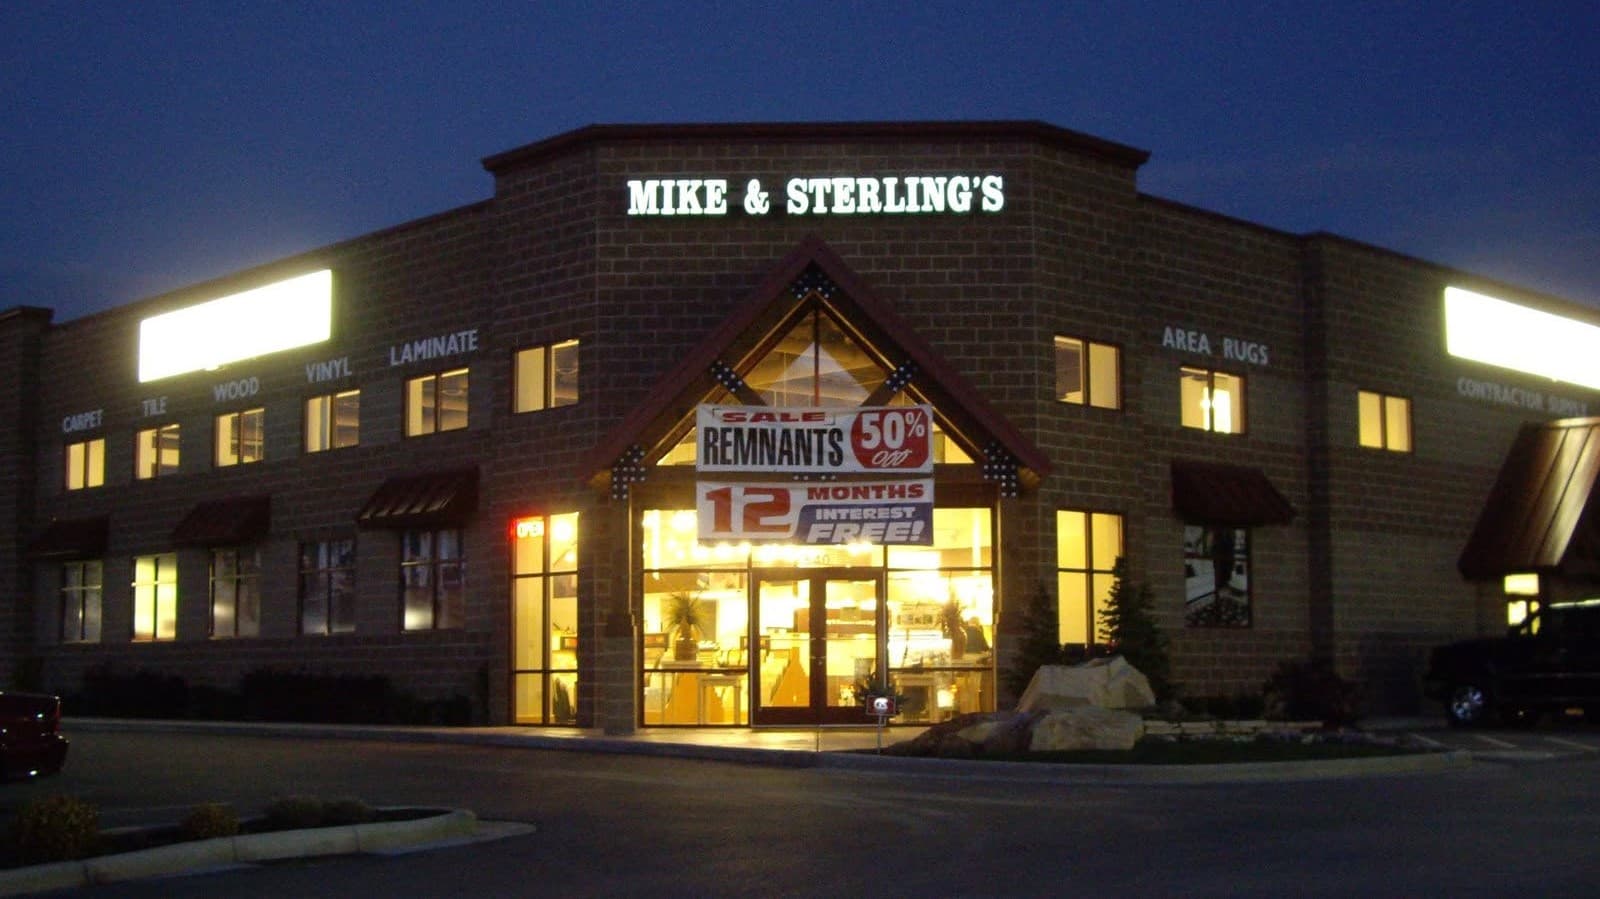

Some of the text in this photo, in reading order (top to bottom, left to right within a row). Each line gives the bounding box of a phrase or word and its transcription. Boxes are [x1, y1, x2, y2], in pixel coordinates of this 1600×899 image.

[627, 175, 1005, 216] MIKE & STERLING'S
[389, 328, 479, 367] LAMINATE
[1162, 325, 1269, 365] AREA RUGS
[305, 356, 352, 383] VINYL
[213, 376, 260, 402] WOOD
[143, 396, 168, 417] TILE
[722, 411, 827, 423] SALE
[62, 409, 104, 433] CARPET
[861, 411, 925, 449] 50%
[703, 427, 843, 466] REMNANTS
[807, 484, 925, 500] MONTHS
[705, 487, 792, 533] 12
[815, 507, 916, 521] INTEREST
[806, 520, 925, 543] FREE!
